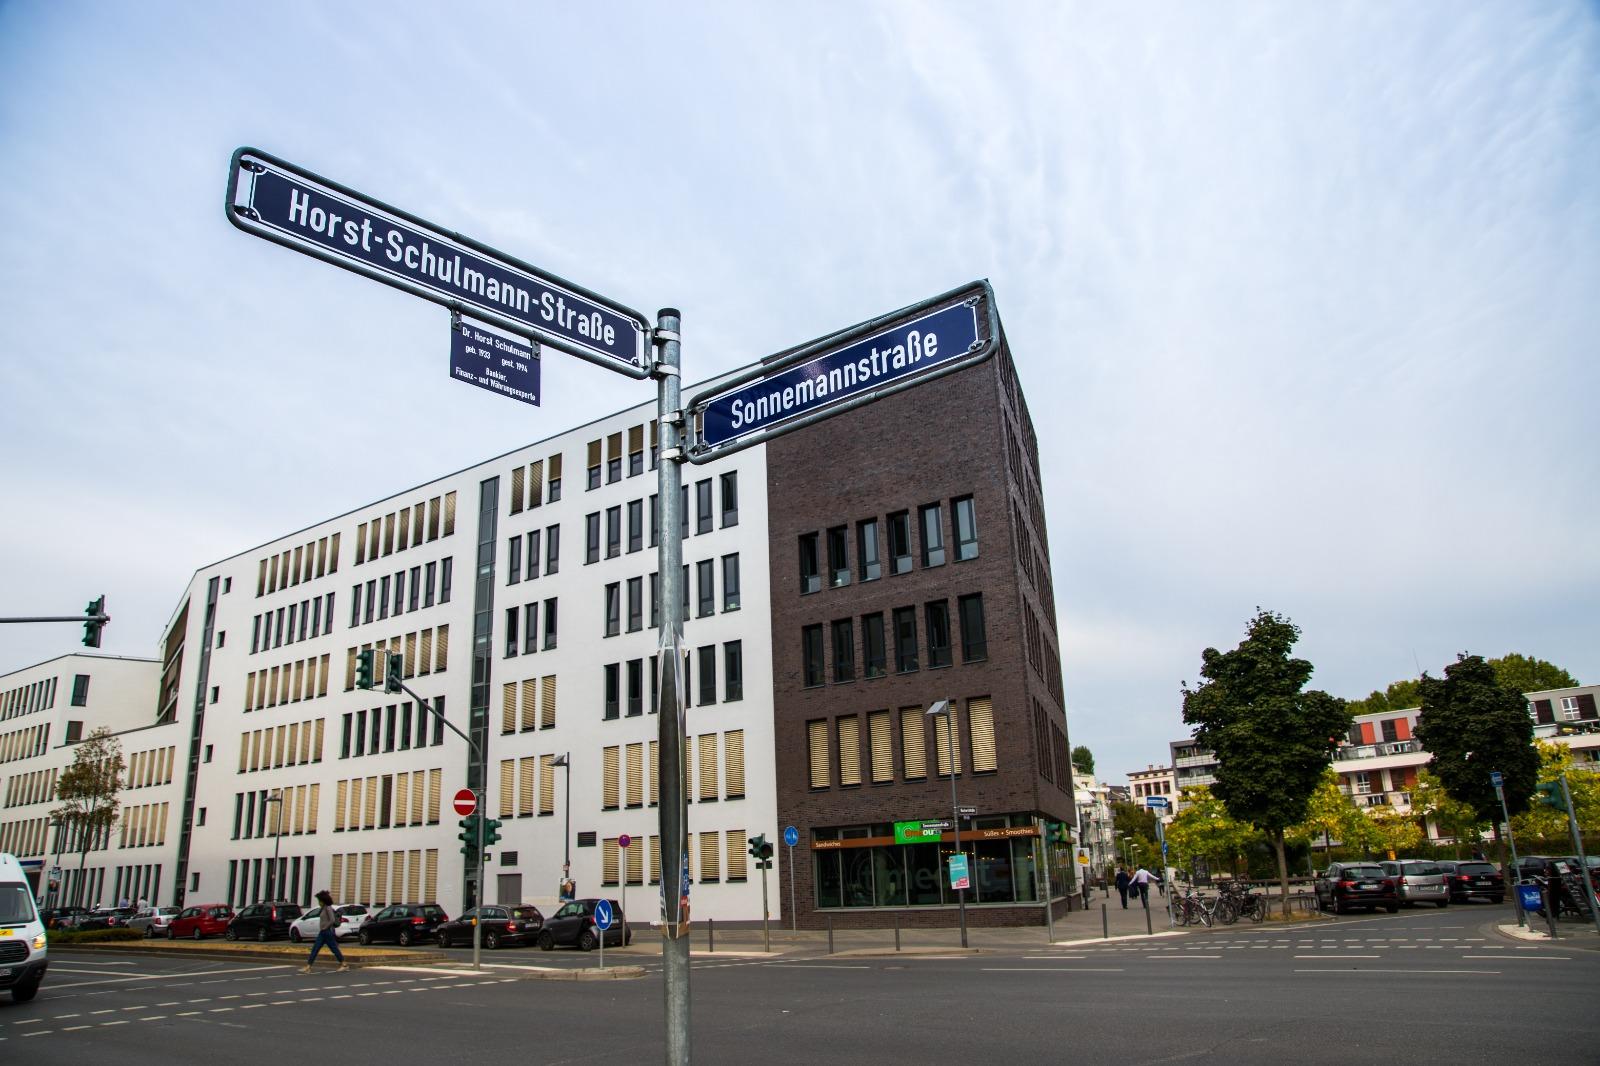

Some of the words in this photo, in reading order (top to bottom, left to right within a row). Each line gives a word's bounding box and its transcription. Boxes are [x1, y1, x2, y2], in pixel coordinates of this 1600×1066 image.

[288, 188, 616, 346] Horst-Schulmann-Straße
[462, 327, 473, 338] Dr.
[474, 332, 493, 345] Horst
[495, 339, 531, 360] Schulmann
[465, 345, 476, 355] geb.
[478, 348, 491, 359] 1933
[516, 362, 528, 373] 1994
[455, 366, 477, 380] Finanz-
[478, 376, 489, 386] und
[489, 378, 536, 401] Währungsexperte
[731, 330, 938, 430] Sonnemannstraße
